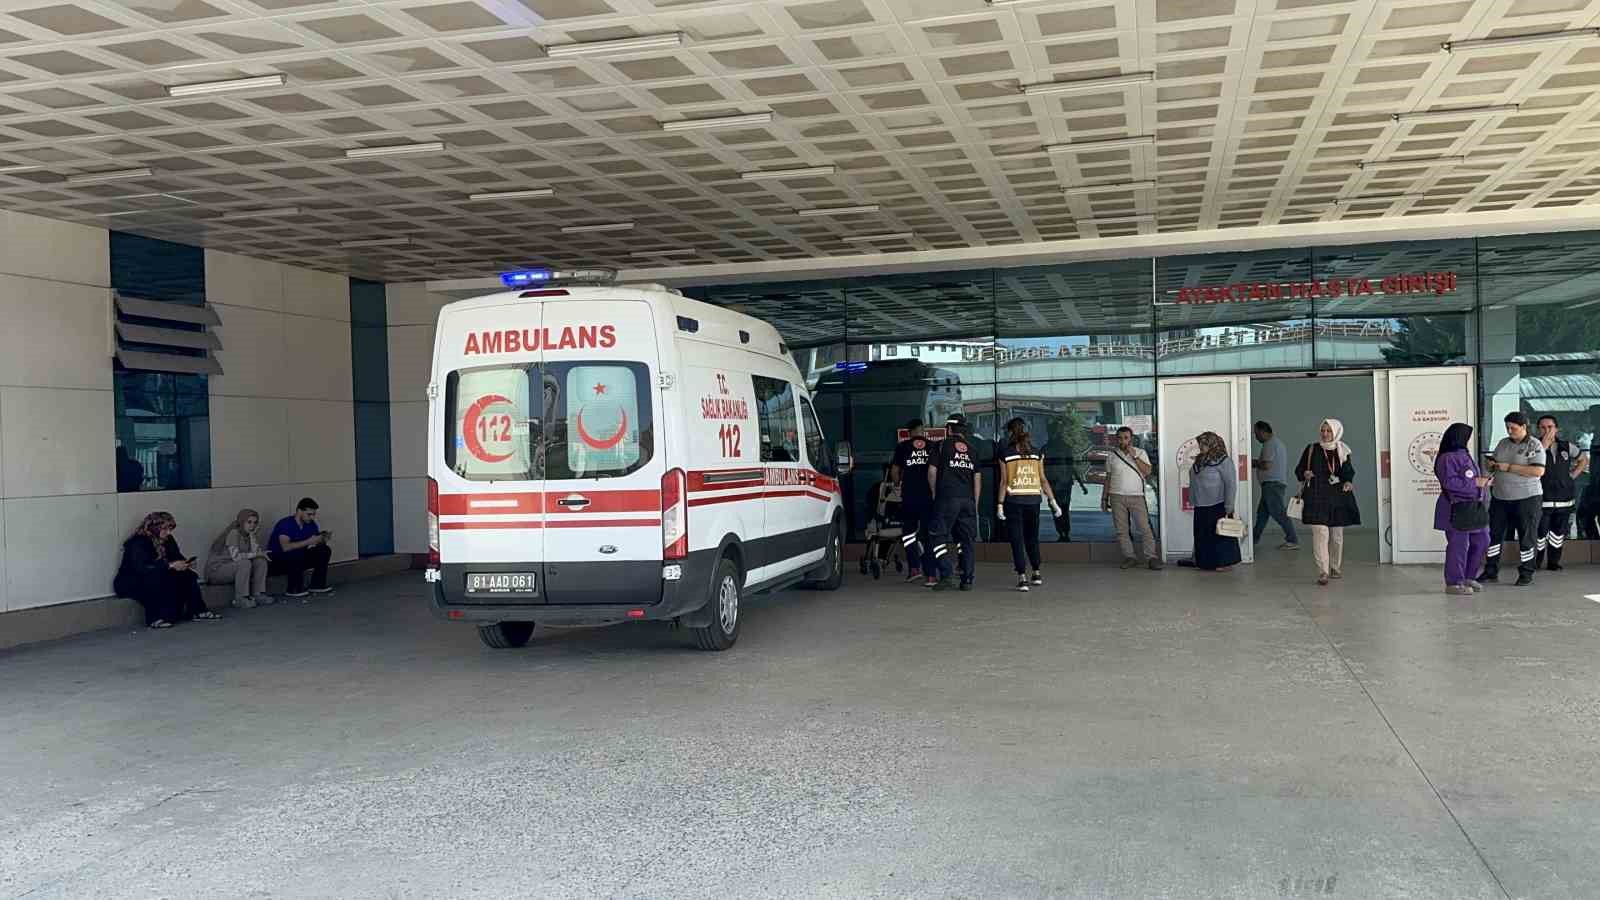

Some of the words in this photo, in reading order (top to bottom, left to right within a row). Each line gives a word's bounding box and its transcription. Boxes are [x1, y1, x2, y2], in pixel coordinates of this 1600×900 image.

[1290, 278, 1374, 300] HASTA
[463, 324, 617, 355] AMBULANS
[478, 415, 512, 443] 112
[719, 424, 741, 458] 112
[911, 449, 930, 458] ACİL
[765, 467, 800, 486] AMBULANS
[1016, 464, 1037, 475] ACİL
[473, 575, 487, 589] 81
[489, 575, 510, 588] AAD
[512, 575, 533, 588] 061
